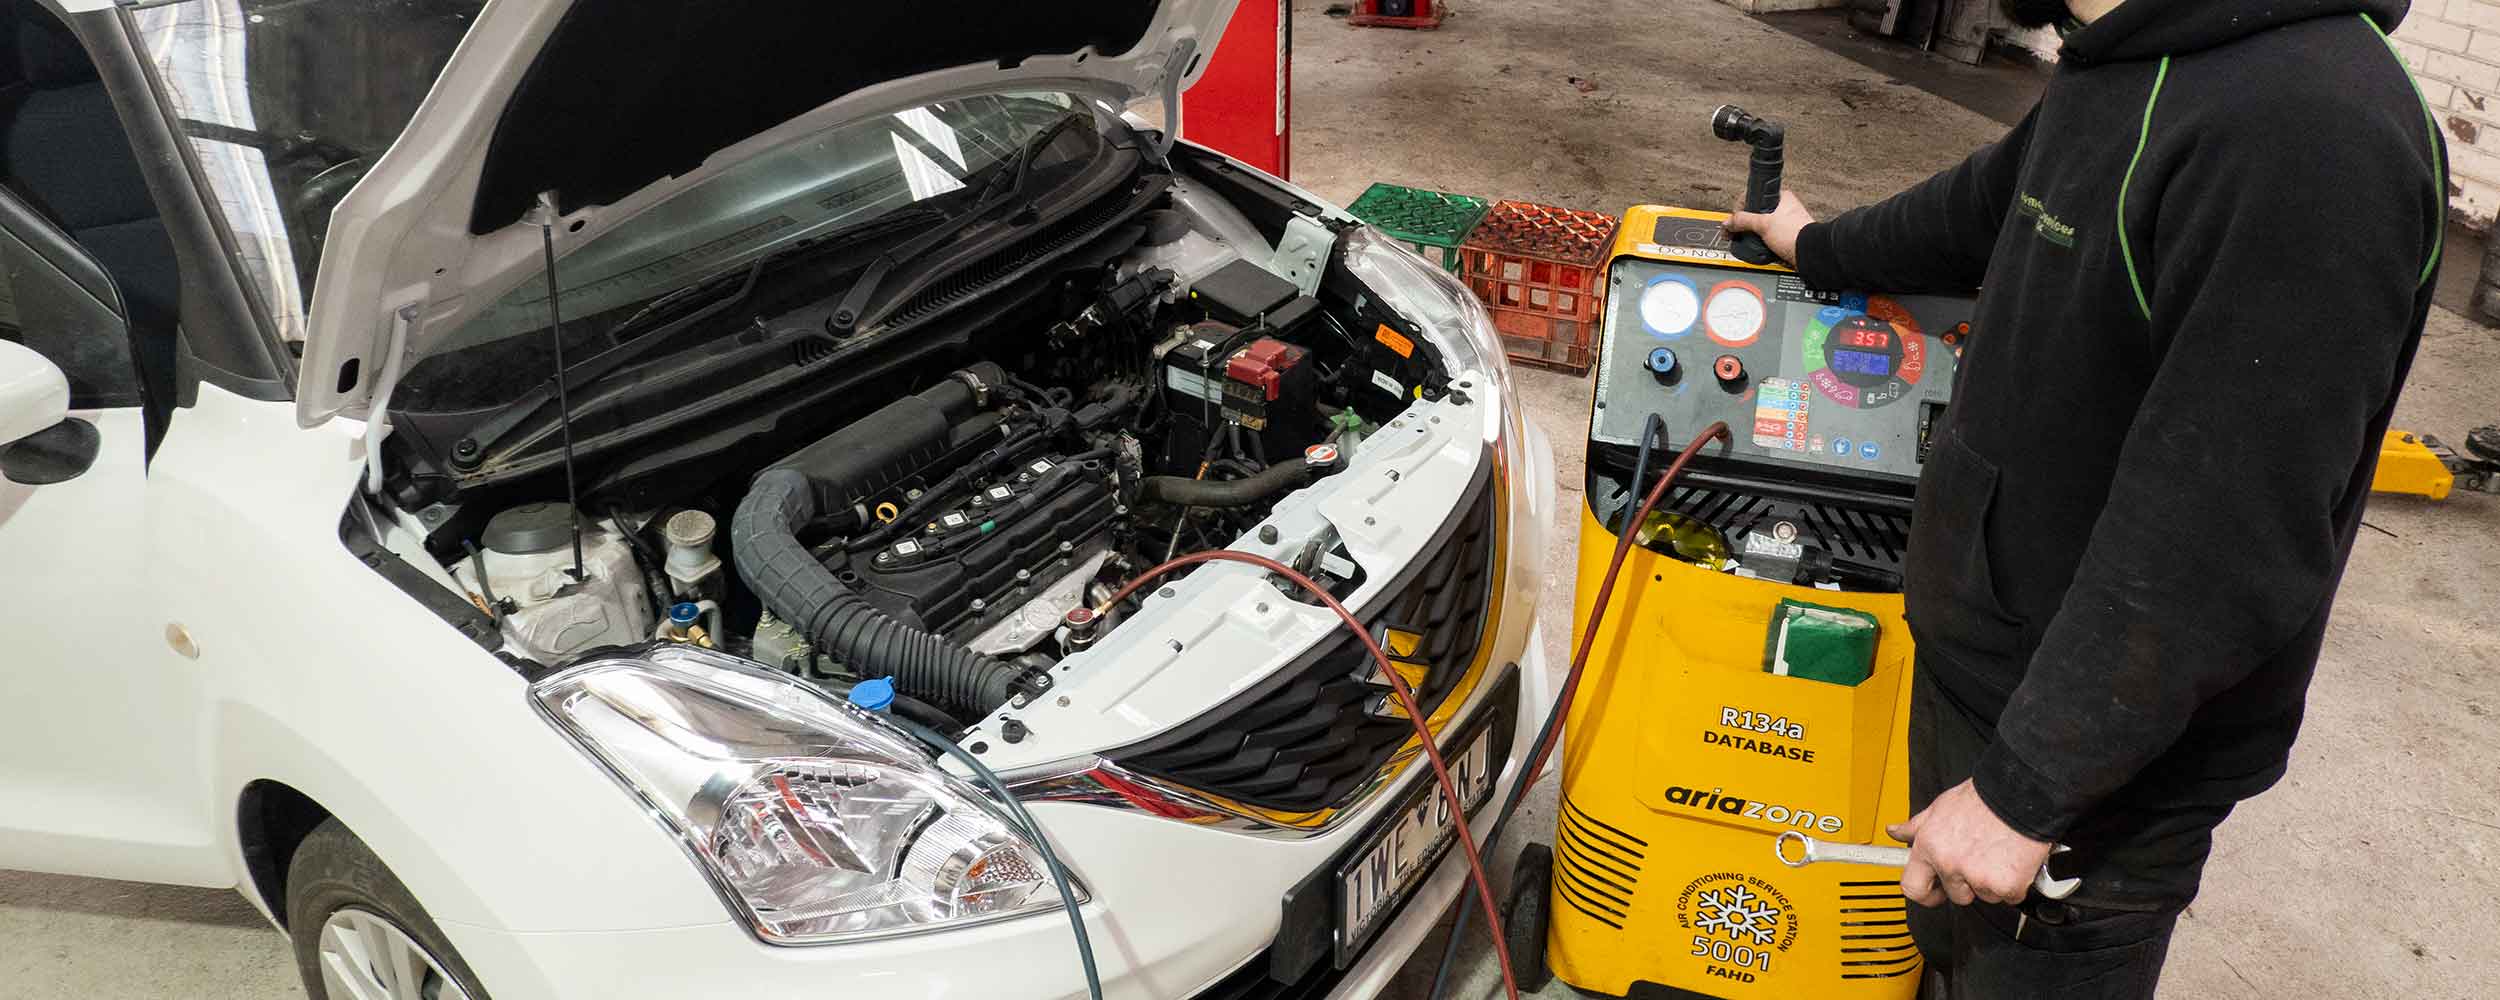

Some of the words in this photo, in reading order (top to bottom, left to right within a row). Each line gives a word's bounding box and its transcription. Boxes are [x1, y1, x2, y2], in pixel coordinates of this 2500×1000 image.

[1657, 246, 1686, 257] DO
[1691, 249, 1730, 260] NOT
[1720, 706, 1805, 740] R134a
[1703, 731, 1815, 763] DATABASE
[1664, 786, 1843, 833] ariazone
[1677, 872, 1744, 911] CONDITIONING
[1748, 877, 1792, 911] SERVICE
[1678, 913, 1691, 929] AIR
[1777, 913, 1798, 952] STATION
[1691, 935, 1771, 972] 5001
[1706, 965, 1756, 983] FAHD
